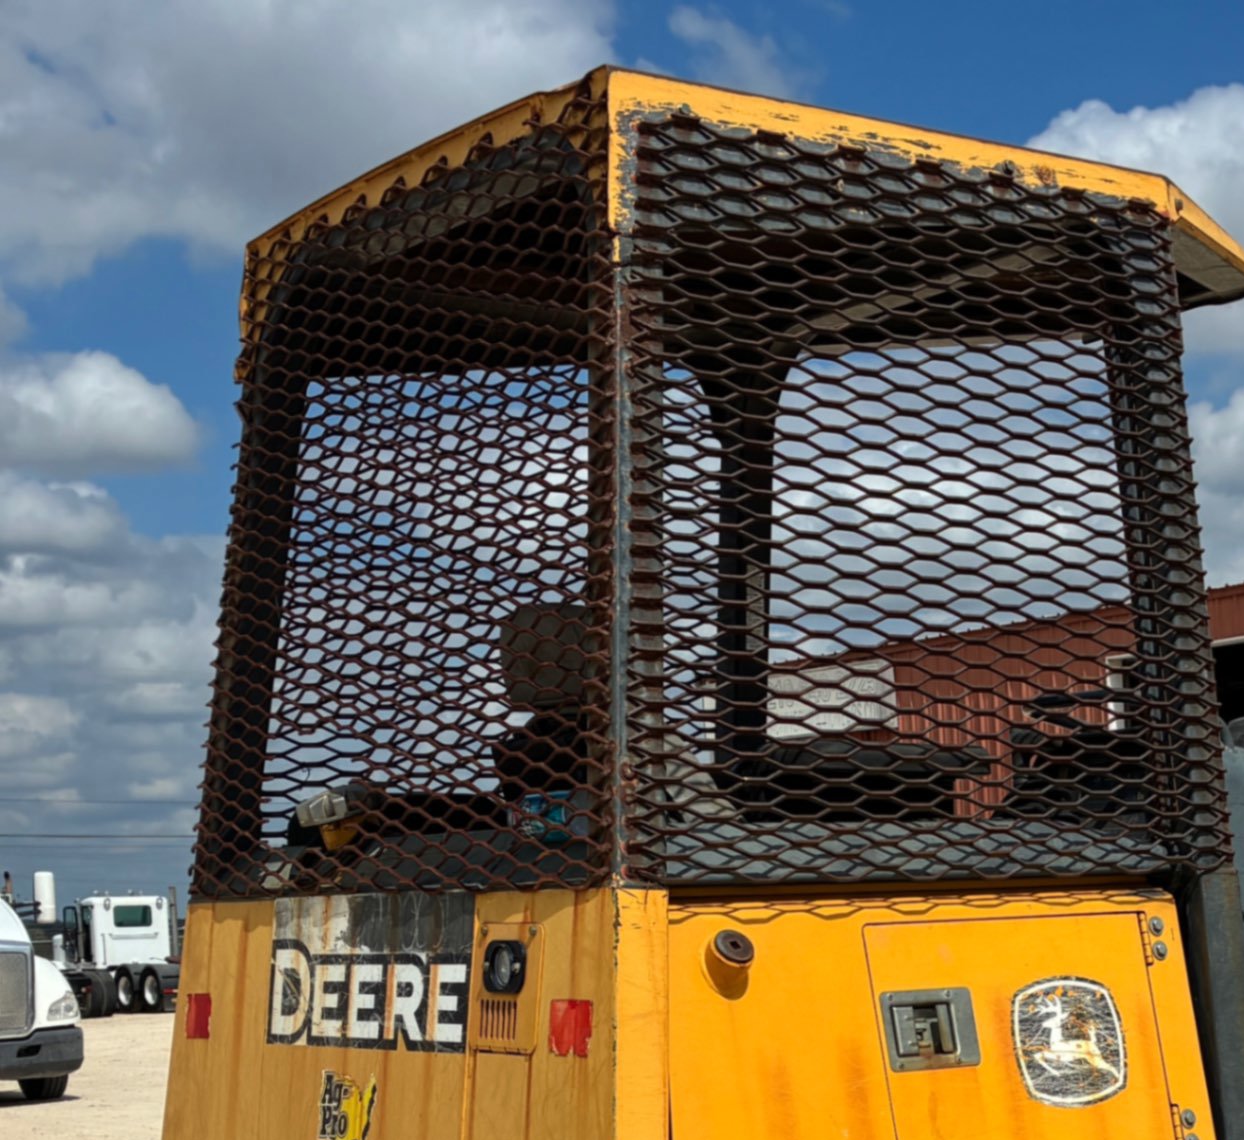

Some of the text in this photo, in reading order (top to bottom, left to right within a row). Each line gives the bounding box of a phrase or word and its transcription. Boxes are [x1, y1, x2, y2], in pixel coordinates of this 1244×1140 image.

[268, 945, 470, 1046] DEERE
[321, 1074, 344, 1111] Ag
[320, 1106, 348, 1136] Pro
